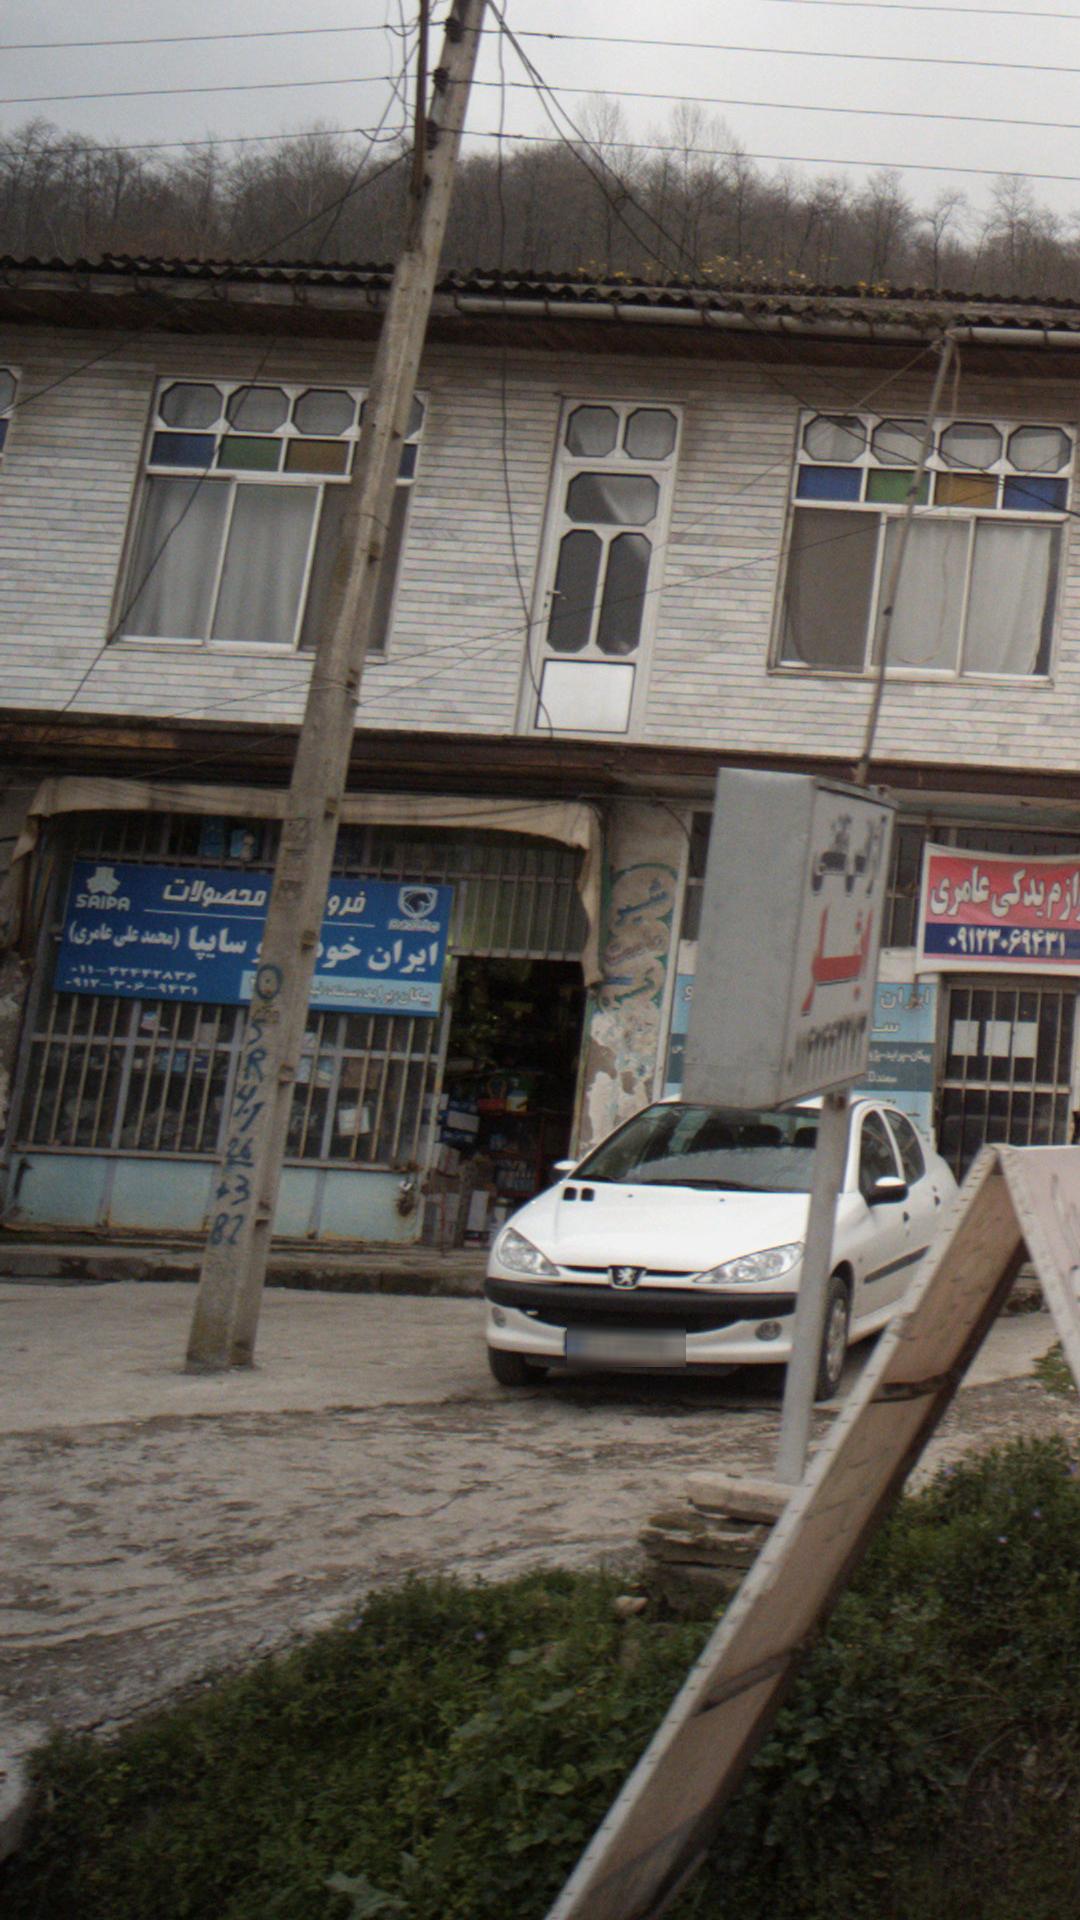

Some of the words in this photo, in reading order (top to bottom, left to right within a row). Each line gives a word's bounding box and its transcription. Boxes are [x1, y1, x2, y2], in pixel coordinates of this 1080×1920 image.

[75, 894, 131, 912] SAIPA
[162, 879, 267, 907] محصولات
[327, 890, 367, 916] فرو
[930, 865, 990, 915] عامری
[991, 868, 1045, 918] یدکی
[113, 925, 140, 948] علی
[188, 925, 247, 960] سایپا
[948, 926, 1066, 957] ۰۹۱۲۳۰۶۹۴۳۱
[367, 939, 439, 974] ایران
